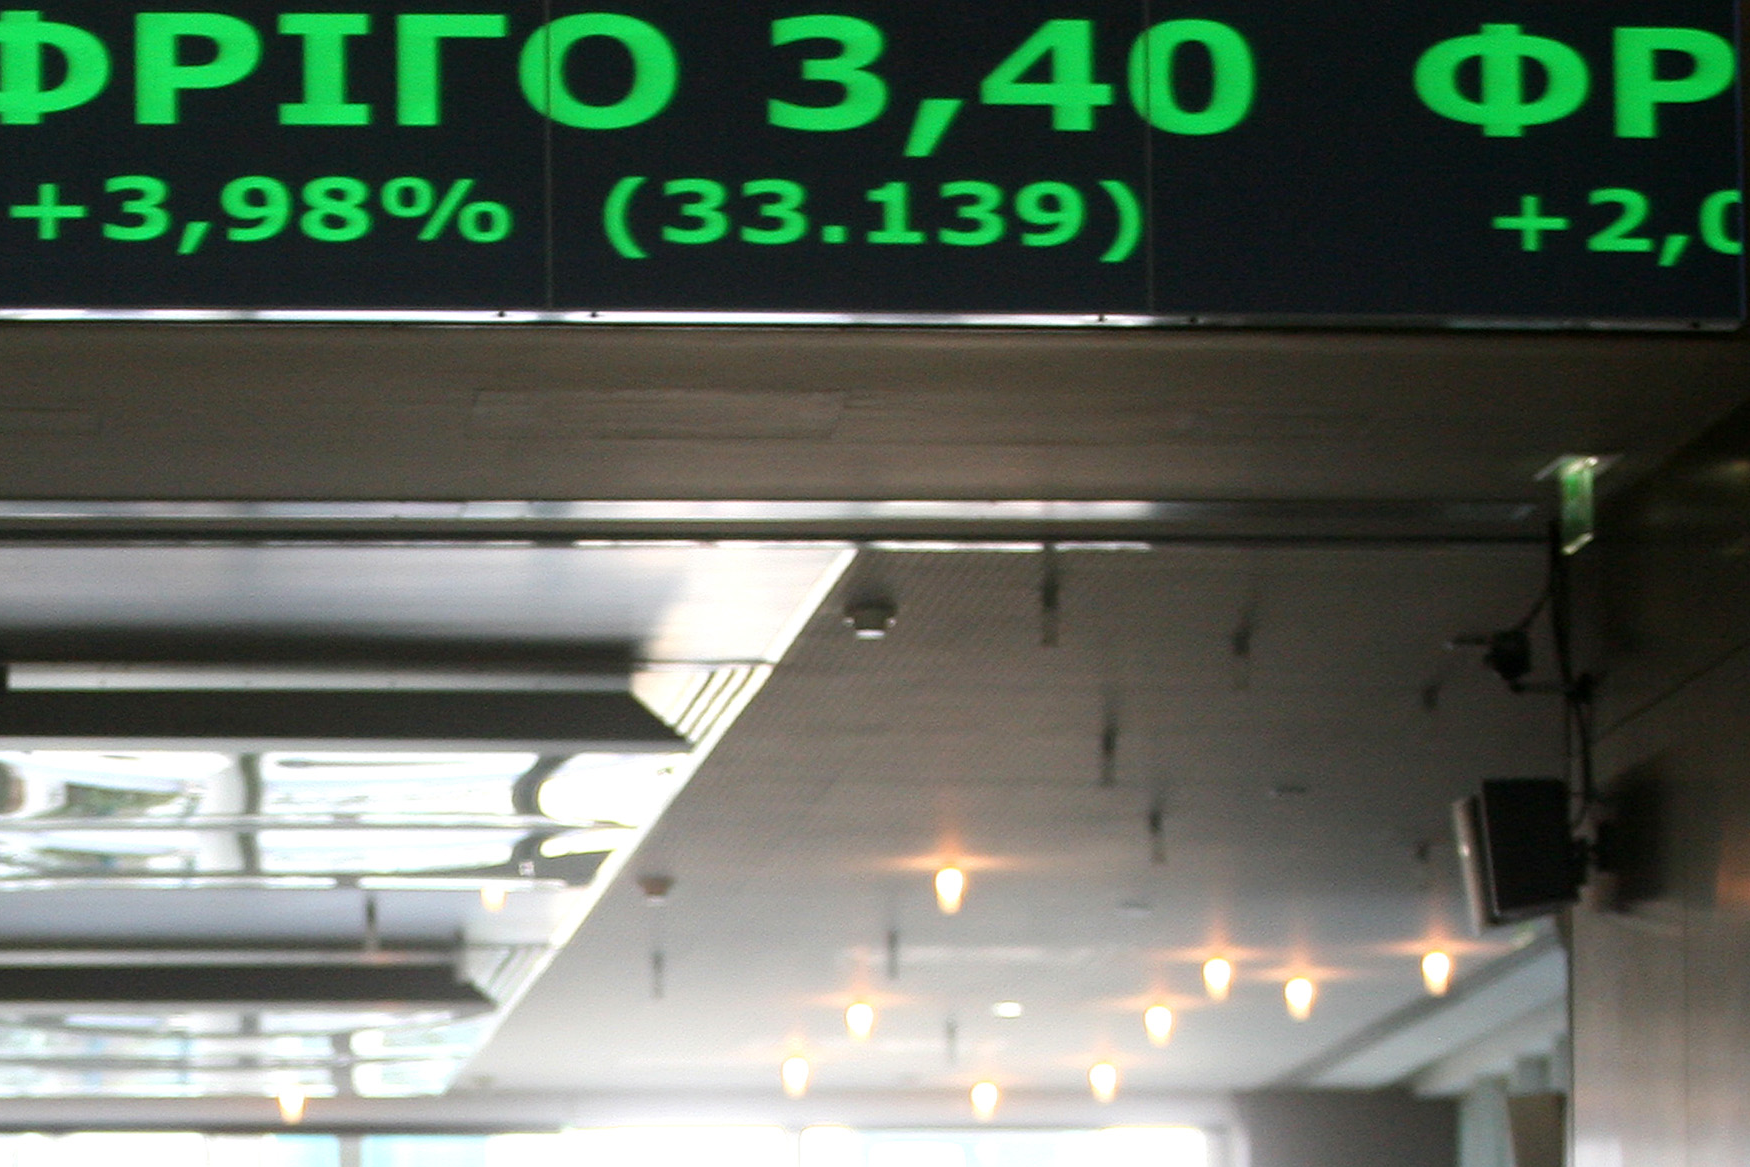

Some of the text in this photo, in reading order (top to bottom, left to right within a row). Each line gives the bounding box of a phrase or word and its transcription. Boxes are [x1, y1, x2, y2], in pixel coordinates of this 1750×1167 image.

[767, 13, 1255, 157] 3,40
[1413, 22, 1736, 138] ΦΡ
[8, 174, 1141, 263] +3,98% (33.139)
